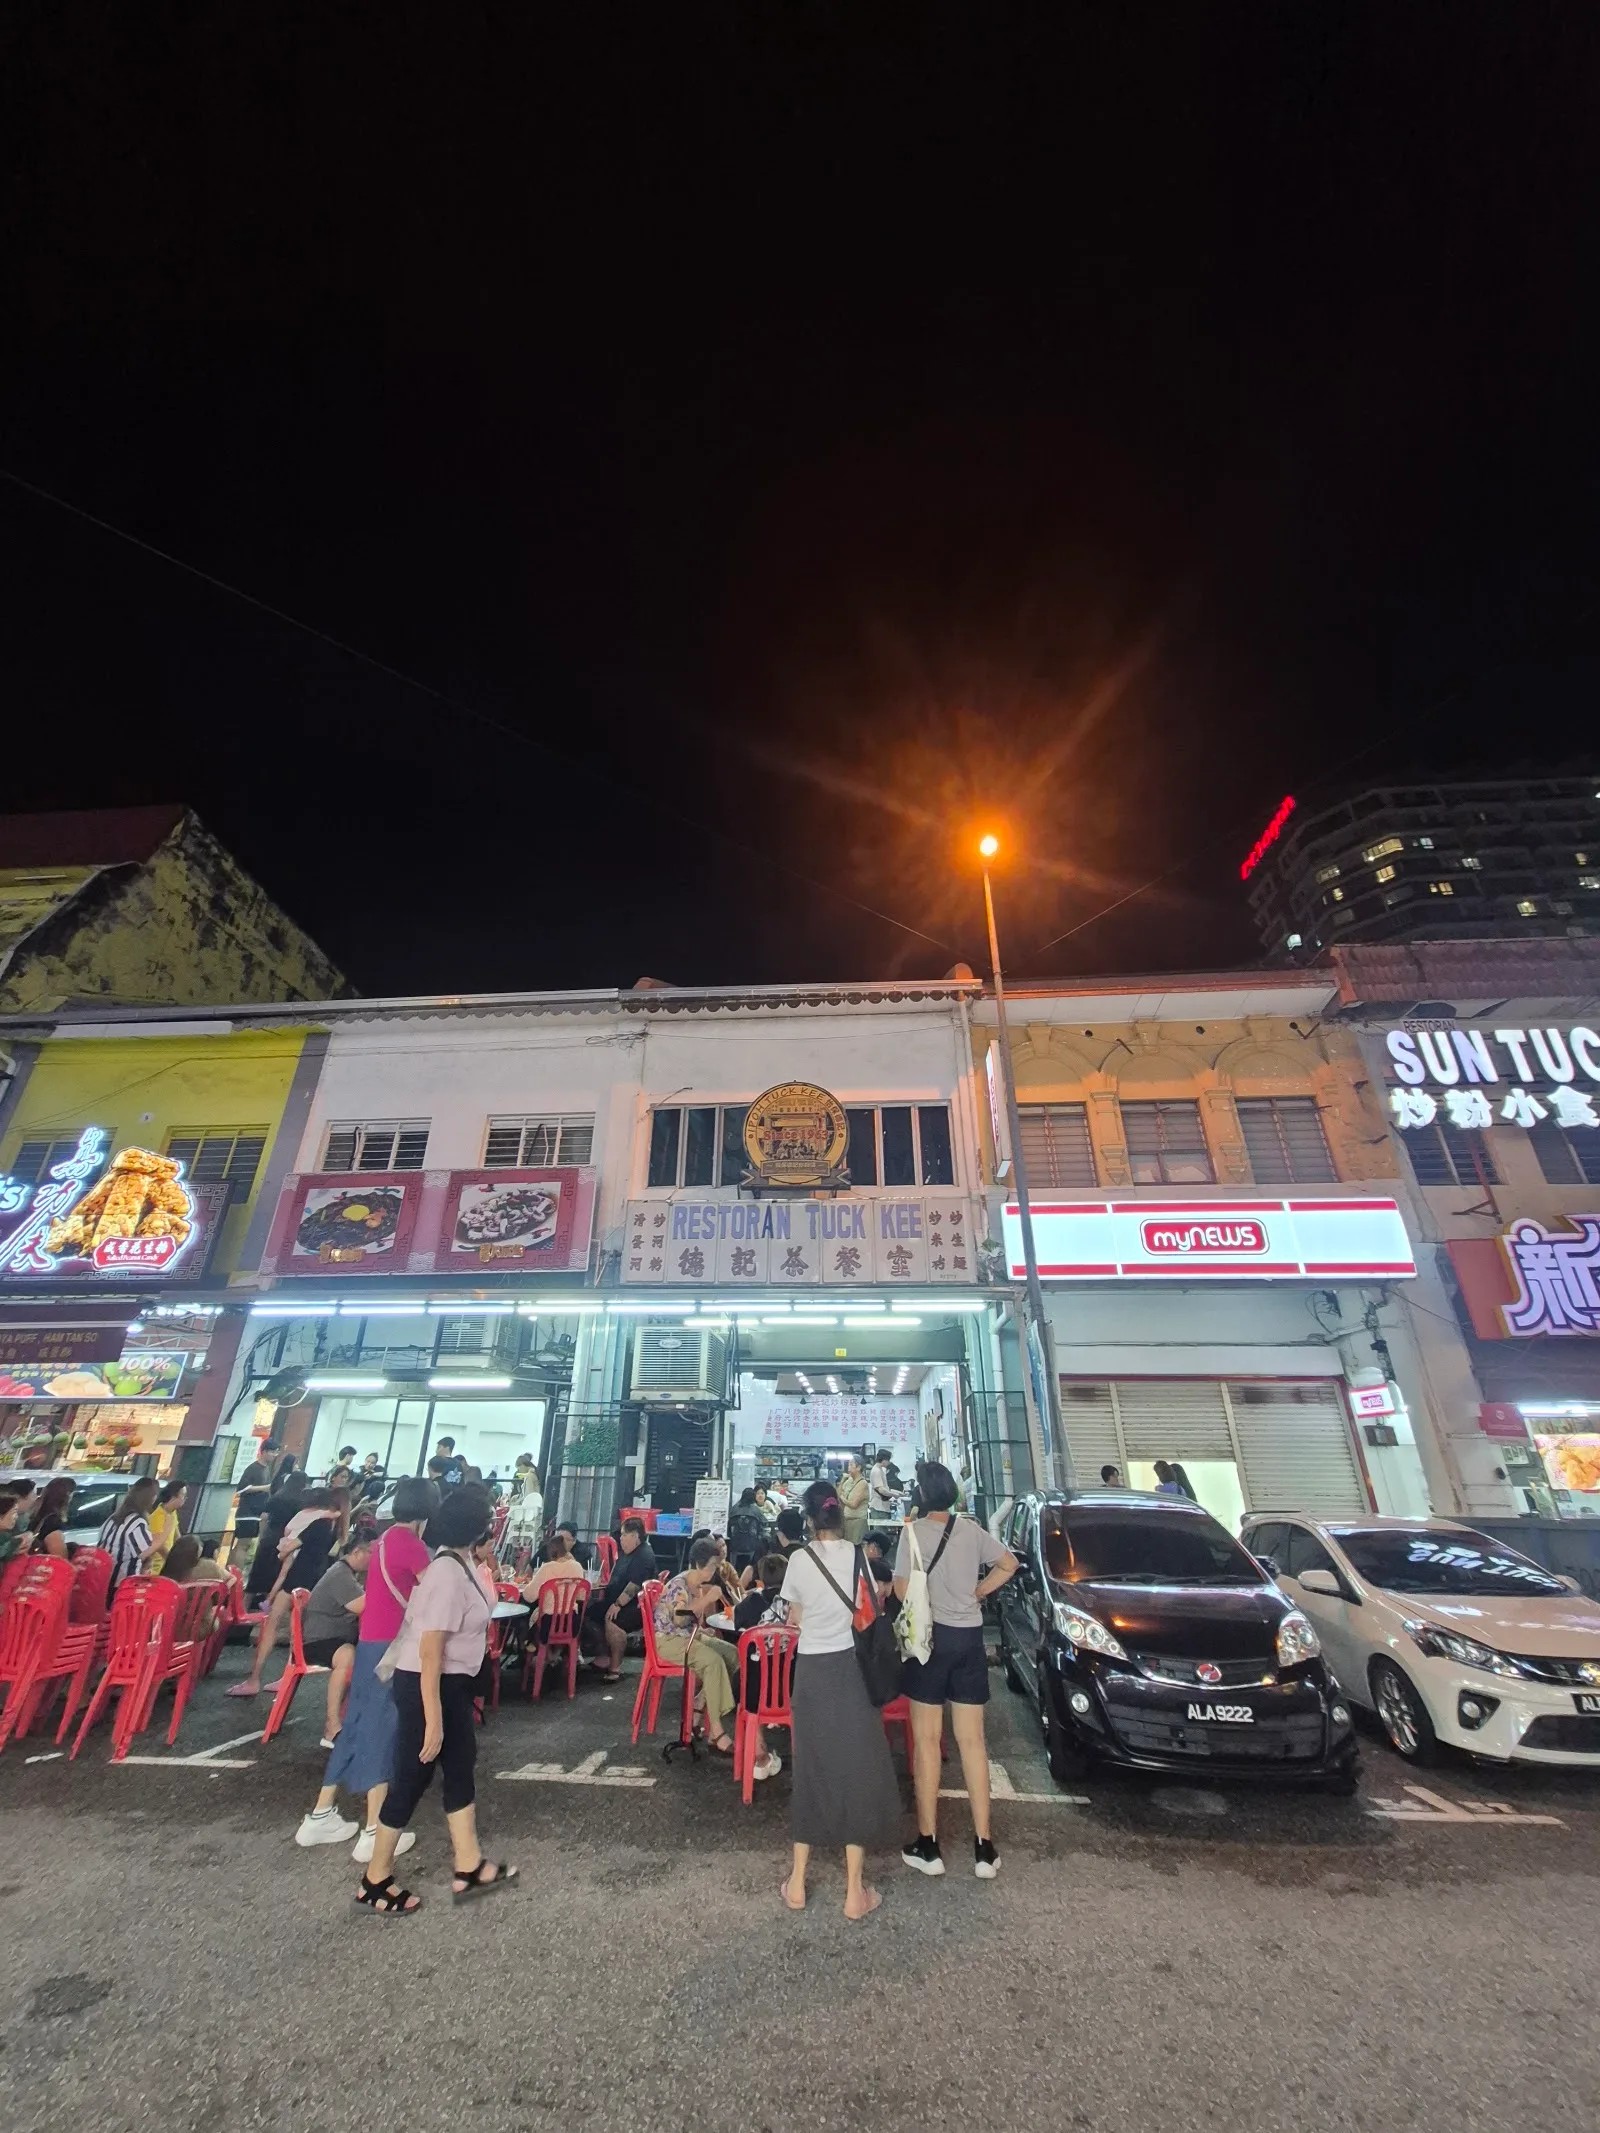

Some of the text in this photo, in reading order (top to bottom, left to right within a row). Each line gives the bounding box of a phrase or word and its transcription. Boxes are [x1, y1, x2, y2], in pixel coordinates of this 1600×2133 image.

[1403, 1020, 1456, 1034] RESTORAN
[1387, 1030, 1499, 1085] SUN
[748, 1106, 765, 1133] IPOH
[765, 1087, 797, 1102] TUCK
[800, 1086, 827, 1101] KEE
[1391, 1085, 1600, 1129] 炒粉小食
[763, 1131, 797, 1140] Since
[672, 1203, 923, 1240] RESTORAN TUCK KEE
[678, 1244, 914, 1278] 德記茶餐室
[1514, 1228, 1600, 1327] 新
[119, 1356, 172, 1371] 100%
[1582, 1696, 1600, 1711] AL
